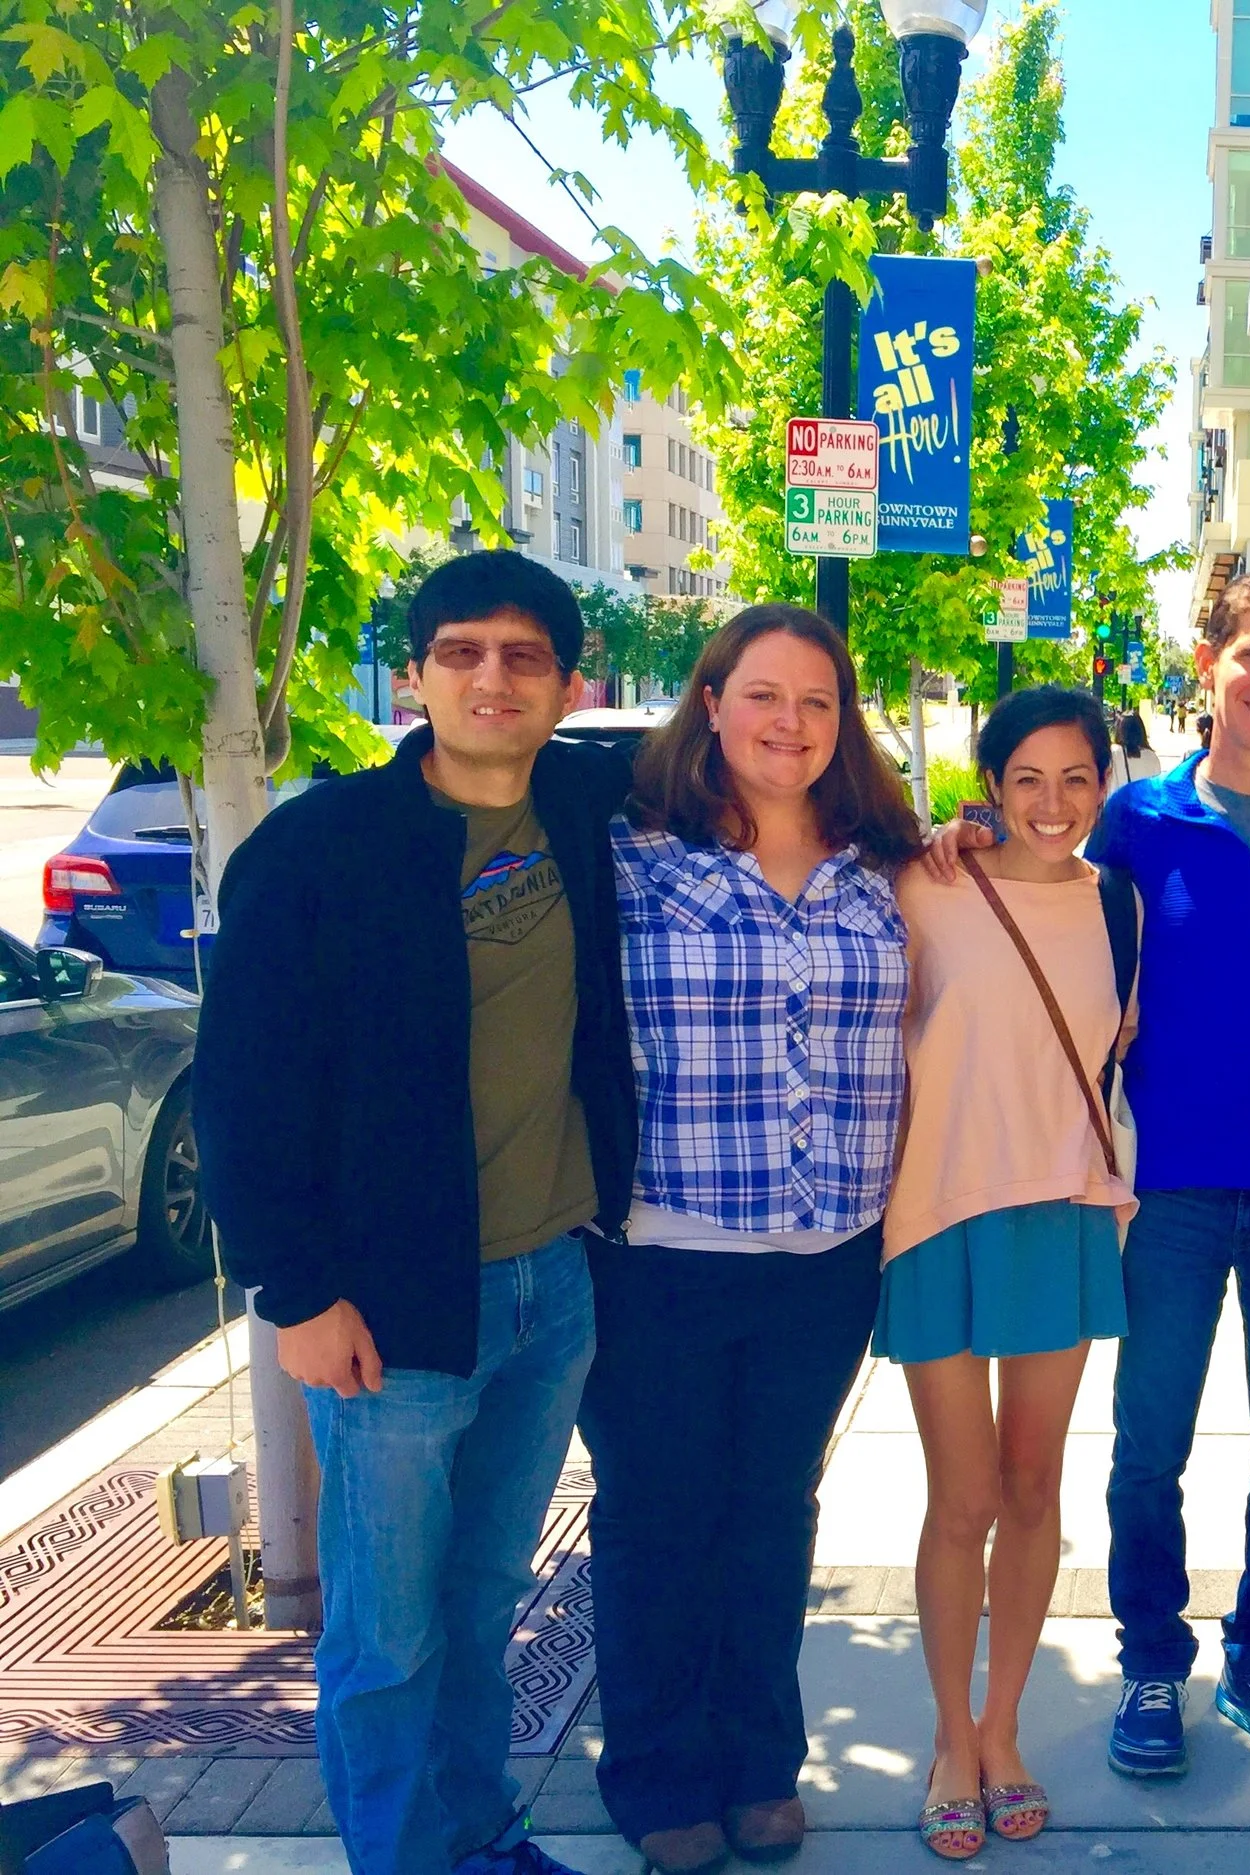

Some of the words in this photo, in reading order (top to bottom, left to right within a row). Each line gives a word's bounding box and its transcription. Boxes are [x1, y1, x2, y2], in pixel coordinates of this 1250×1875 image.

[874, 320, 960, 372] It's
[873, 364, 935, 414] all
[791, 425, 817, 452] NO
[819, 432, 874, 451] PARKING
[872, 377, 961, 485] Here!
[836, 464, 845, 472] TO
[792, 493, 809, 519] 3
[827, 496, 860, 509] HOUR
[878, 503, 958, 517] OWNTOWN
[817, 508, 872, 527] PARKING
[1025, 529, 1066, 553] Its
[986, 611, 995, 624] 3
[1028, 614, 1067, 622] OWNTOWN
[1028, 620, 1065, 628] UNNYVALE
